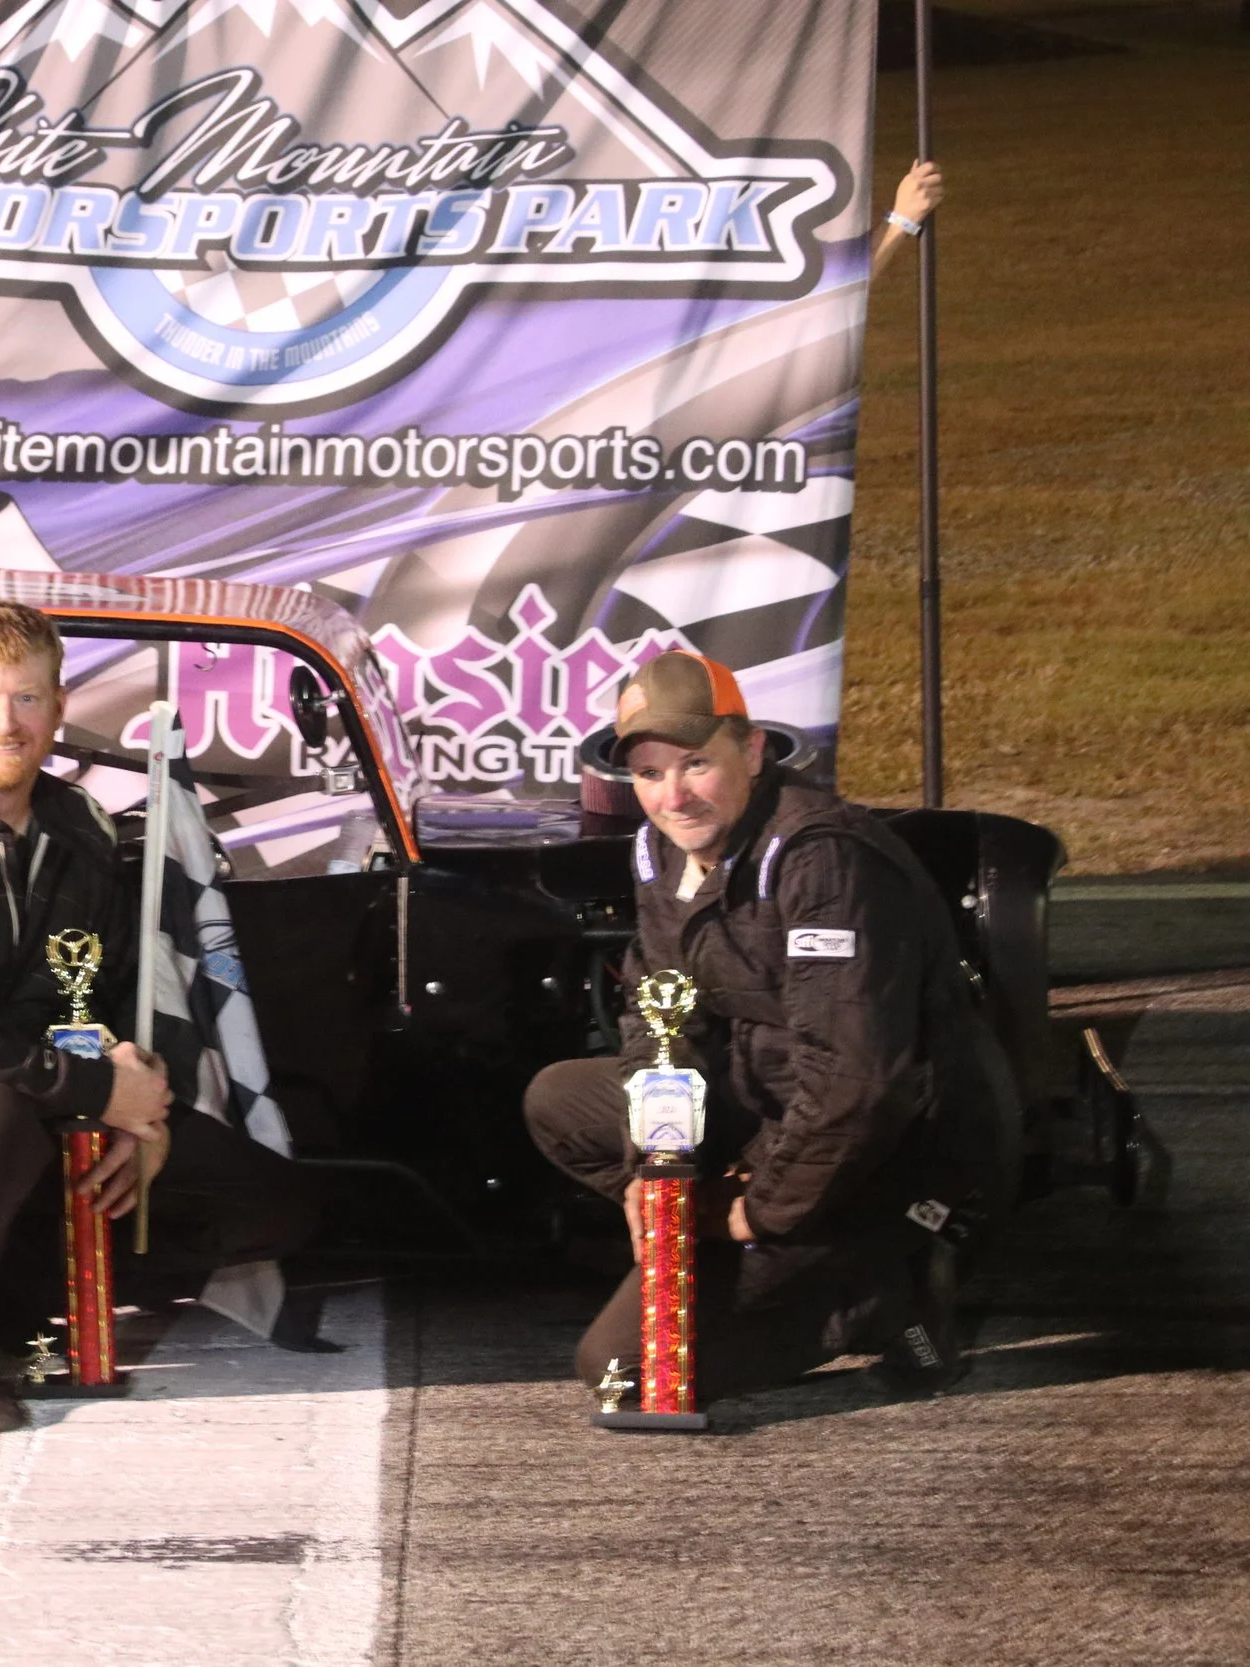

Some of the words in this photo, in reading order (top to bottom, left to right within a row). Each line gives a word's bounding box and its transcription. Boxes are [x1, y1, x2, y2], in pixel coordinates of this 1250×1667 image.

[134, 66, 574, 201] Mountain
[486, 179, 791, 255] PARK
[154, 313, 226, 366] THUNDER
[224, 345, 244, 370] IN
[250, 347, 279, 371] THE
[284, 310, 380, 367] MOUNTAINS
